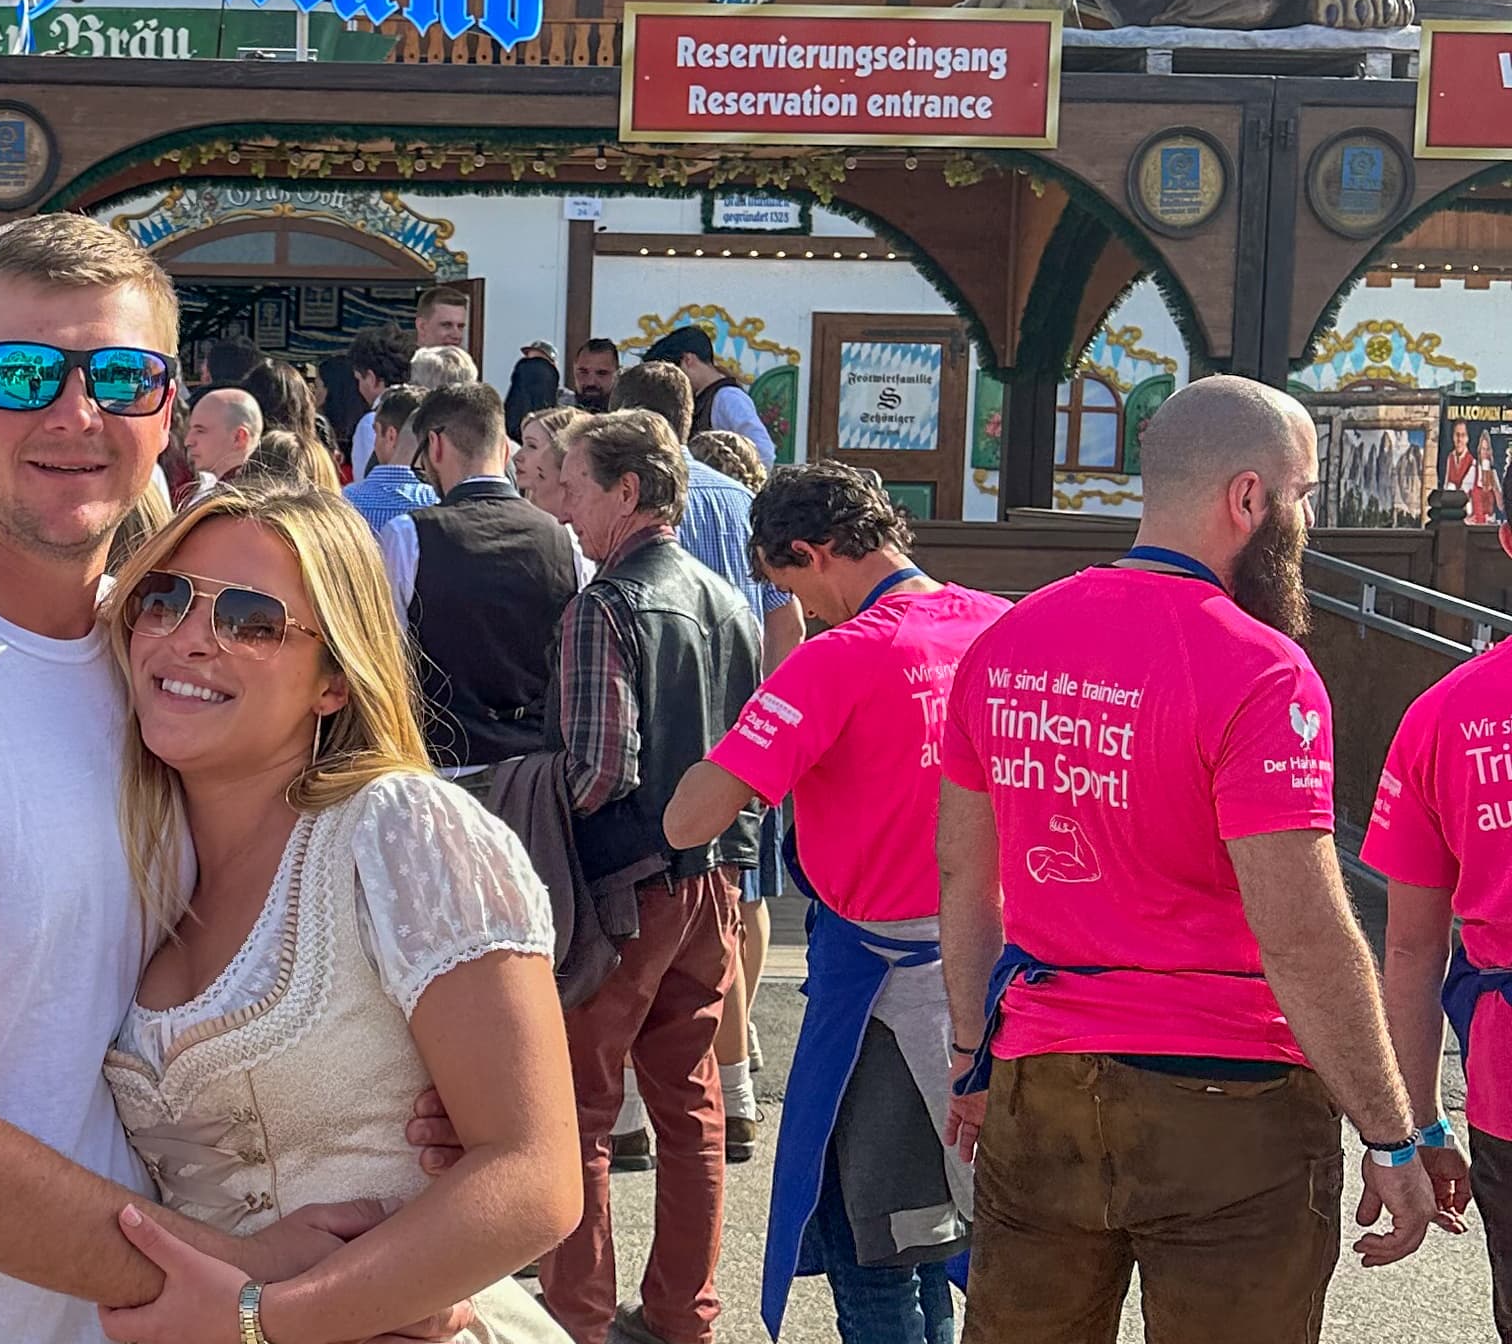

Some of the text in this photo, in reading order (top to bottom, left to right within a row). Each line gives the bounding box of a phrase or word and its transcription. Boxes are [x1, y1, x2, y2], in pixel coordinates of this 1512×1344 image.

[49, 12, 197, 58] Bräu
[676, 35, 1007, 79] Reservierungseingang
[688, 84, 994, 119] Reservation entrance
[988, 667, 1145, 708] Wir sind alle trainiert!
[987, 698, 1134, 760] Trinken ist
[1460, 718, 1497, 741] Wir
[991, 747, 1128, 809] auch Sport!
[1264, 760, 1287, 773] Der
